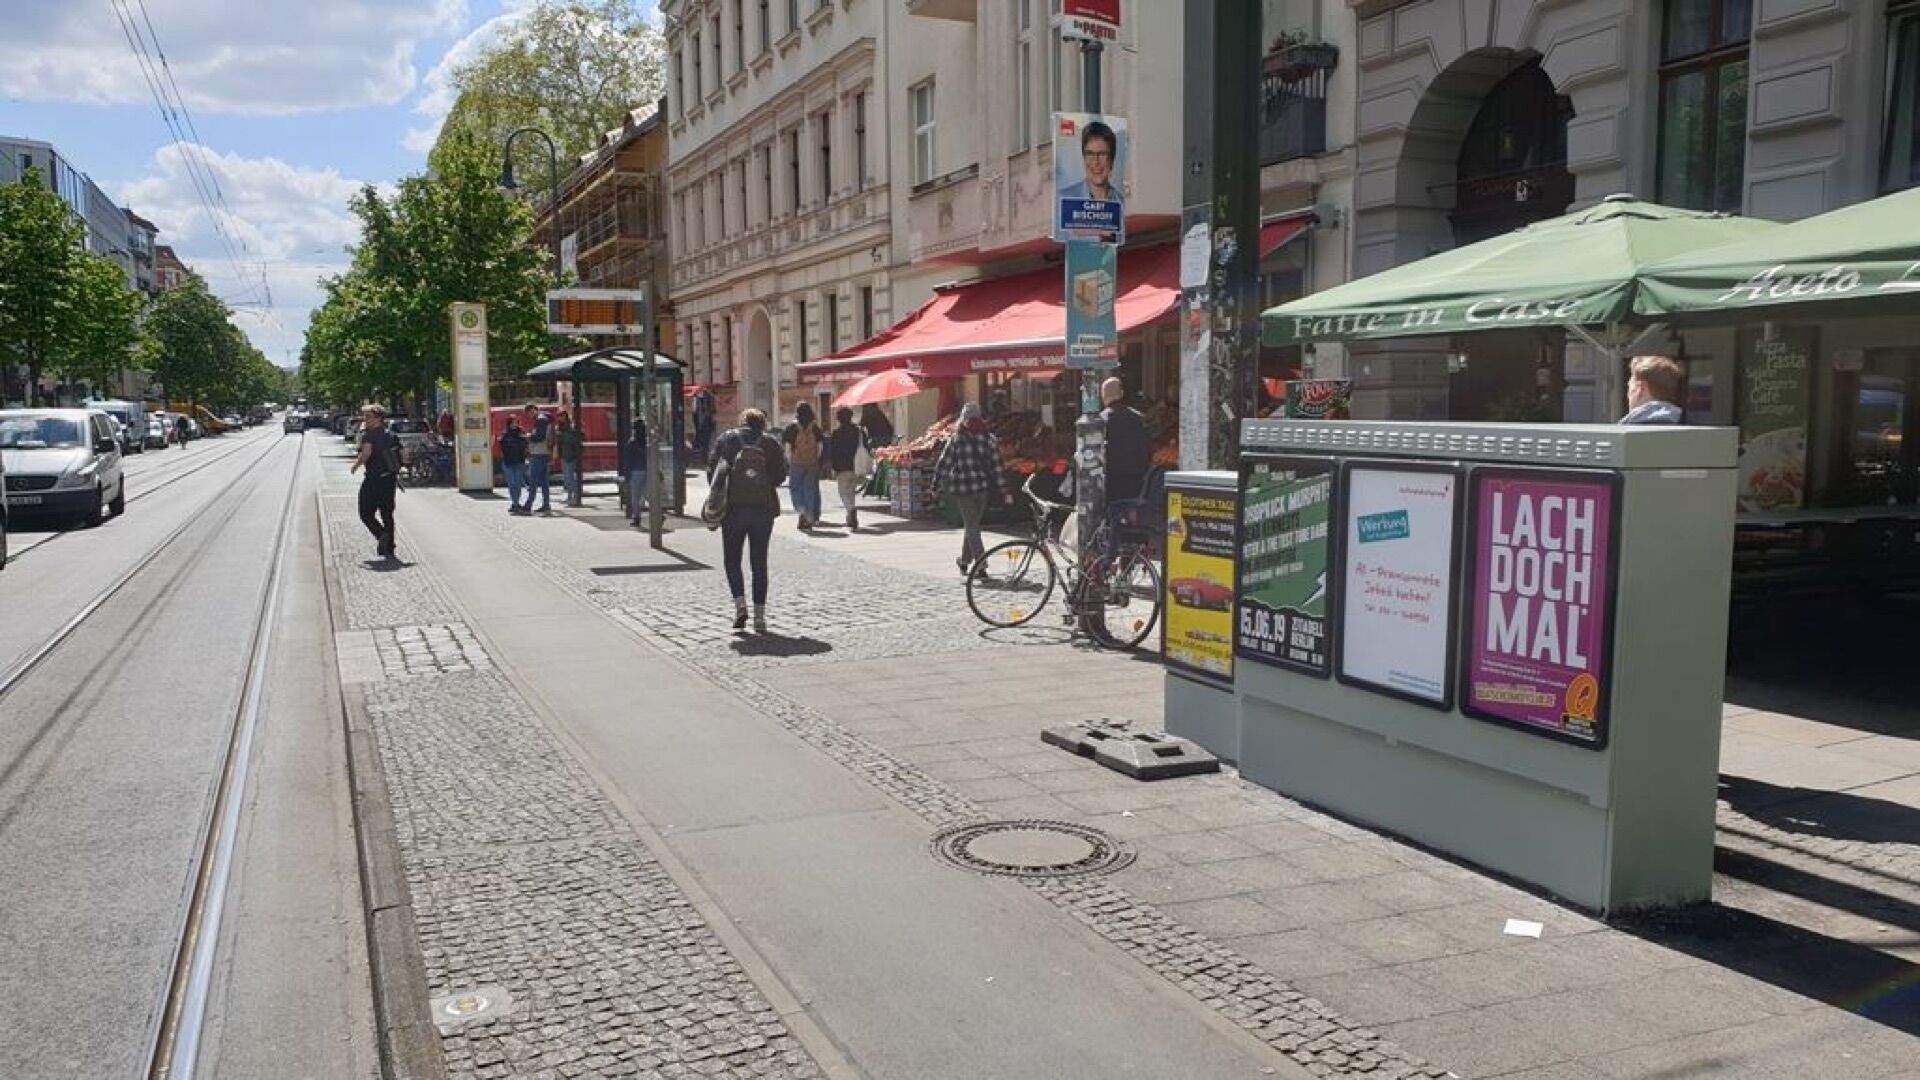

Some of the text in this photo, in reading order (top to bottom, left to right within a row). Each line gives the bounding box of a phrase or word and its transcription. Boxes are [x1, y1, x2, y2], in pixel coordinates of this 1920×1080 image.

[1400, 306, 1444, 329] in
[1463, 297, 1581, 322] Case
[1767, 352, 1806, 369] Pasta
[1492, 492, 1595, 554] LACH
[1490, 545, 1592, 605] DOCH
